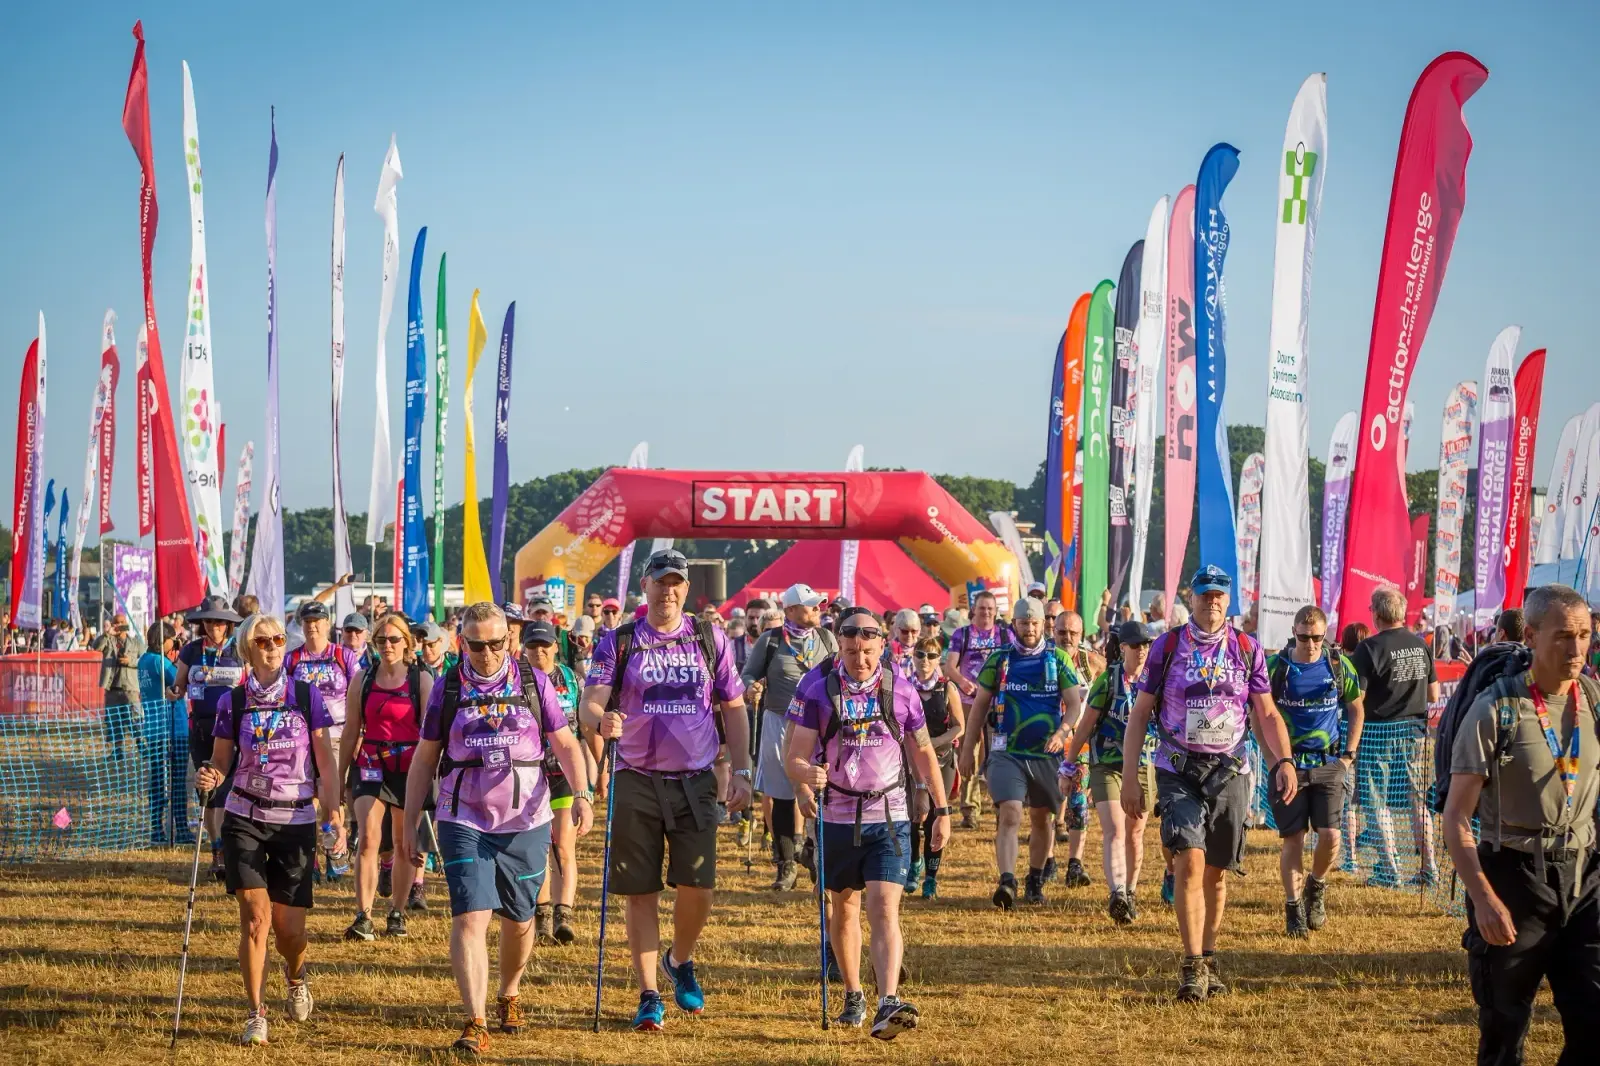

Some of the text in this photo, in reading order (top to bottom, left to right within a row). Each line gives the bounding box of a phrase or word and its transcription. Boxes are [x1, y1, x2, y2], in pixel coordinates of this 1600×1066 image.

[1386, 191, 1433, 424] actionchallenge
[1089, 335, 1105, 458] NSPCC
[1482, 439, 1496, 496] COAST
[1509, 415, 1531, 549] actionchallenge
[101, 482, 111, 523] WALK
[142, 487, 151, 526] WALK
[702, 487, 838, 521] START
[1323, 492, 1337, 605] JURASSIC COAST
[642, 666, 699, 683] COAST
[643, 703, 697, 714] CHALLENGE
[251, 740, 296, 751] CLLENGE
[464, 735, 520, 748] CHALLENGE
